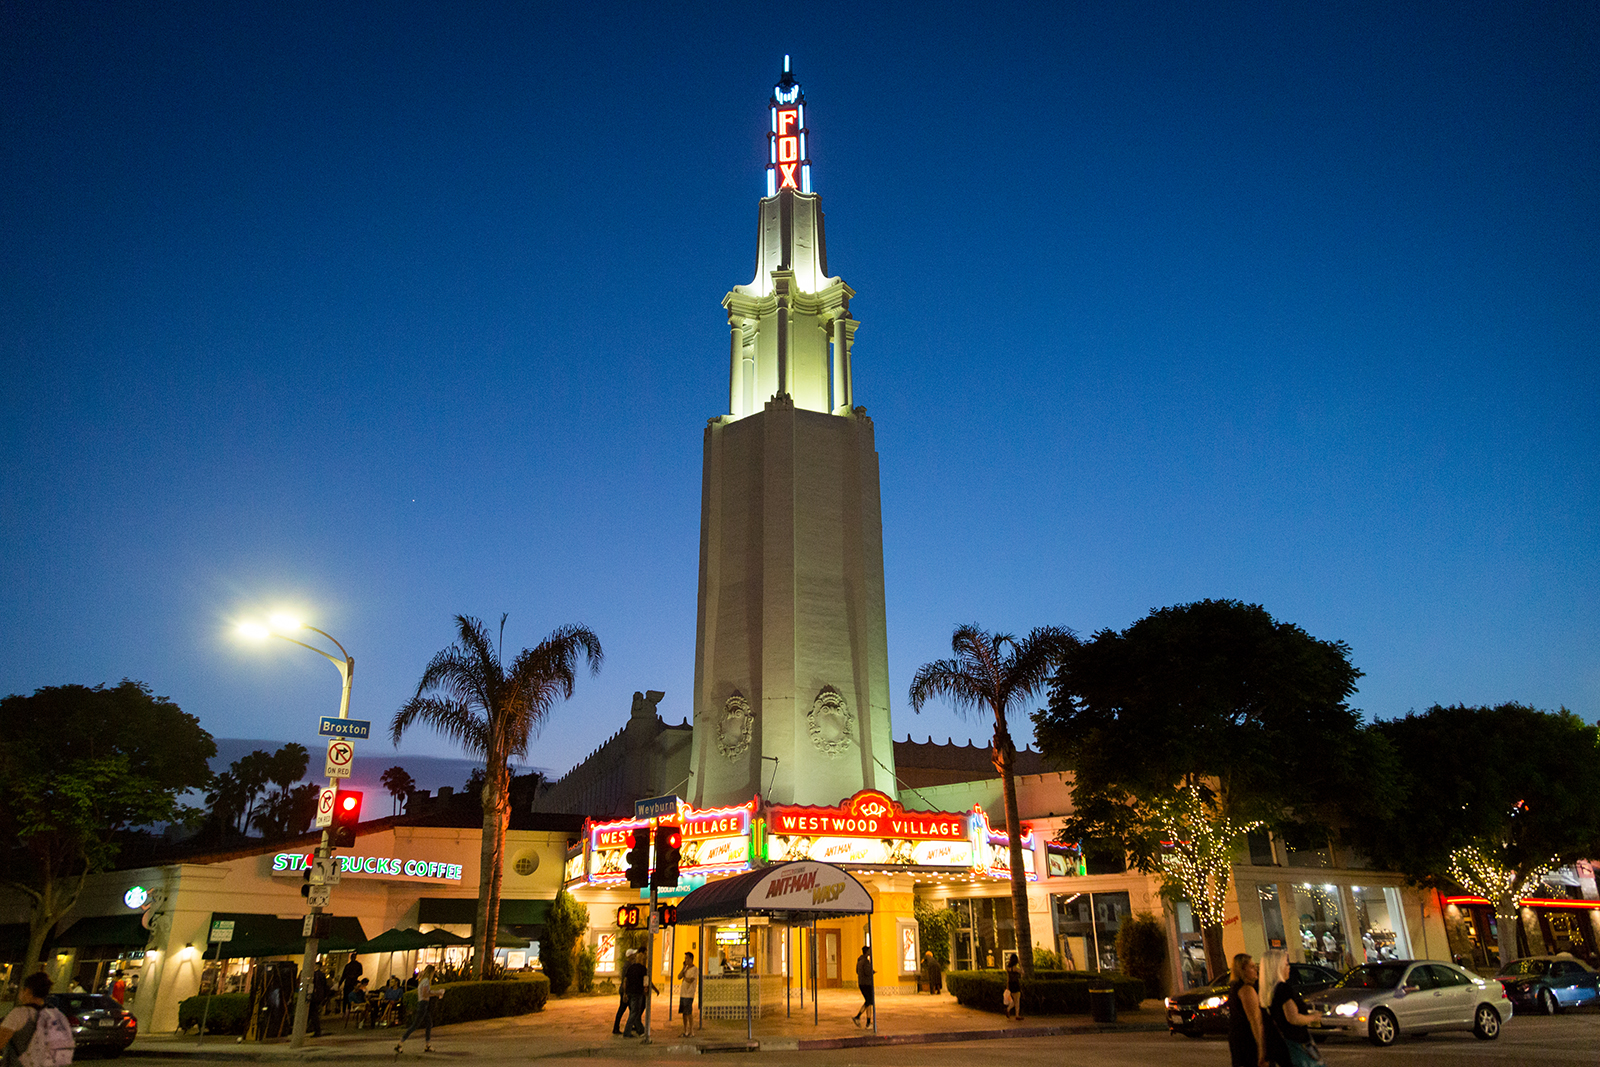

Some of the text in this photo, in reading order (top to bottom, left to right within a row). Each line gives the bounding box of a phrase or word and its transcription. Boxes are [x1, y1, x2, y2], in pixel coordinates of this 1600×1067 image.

[778, 110, 798, 188] FOX
[322, 721, 367, 735] Broxton
[327, 766, 349, 775] ON RED
[638, 801, 675, 816] Weyburn
[859, 801, 886, 817] FOX
[680, 817, 738, 835] VILLAGE
[782, 816, 960, 836] WESTWOOD VILLAGE
[404, 859, 462, 880] COFFEE
[812, 881, 846, 906] WASP
[629, 909, 637, 925] 13
